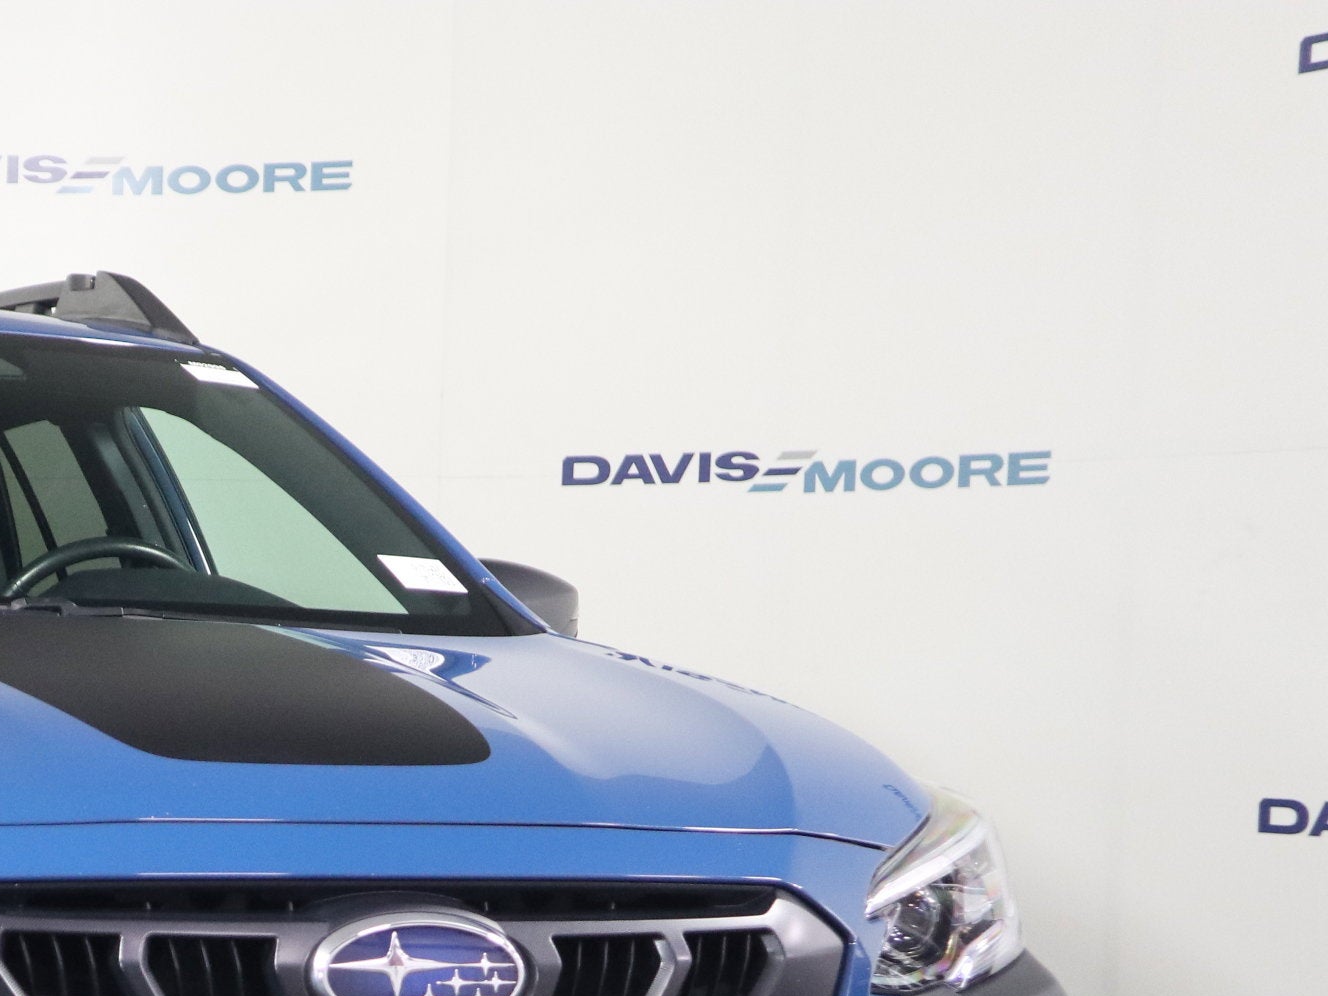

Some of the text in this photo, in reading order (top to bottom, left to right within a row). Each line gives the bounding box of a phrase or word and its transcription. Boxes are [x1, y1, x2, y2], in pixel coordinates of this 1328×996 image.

[110, 160, 353, 196] MOORE
[562, 450, 1052, 493] DAVIS MOORE
